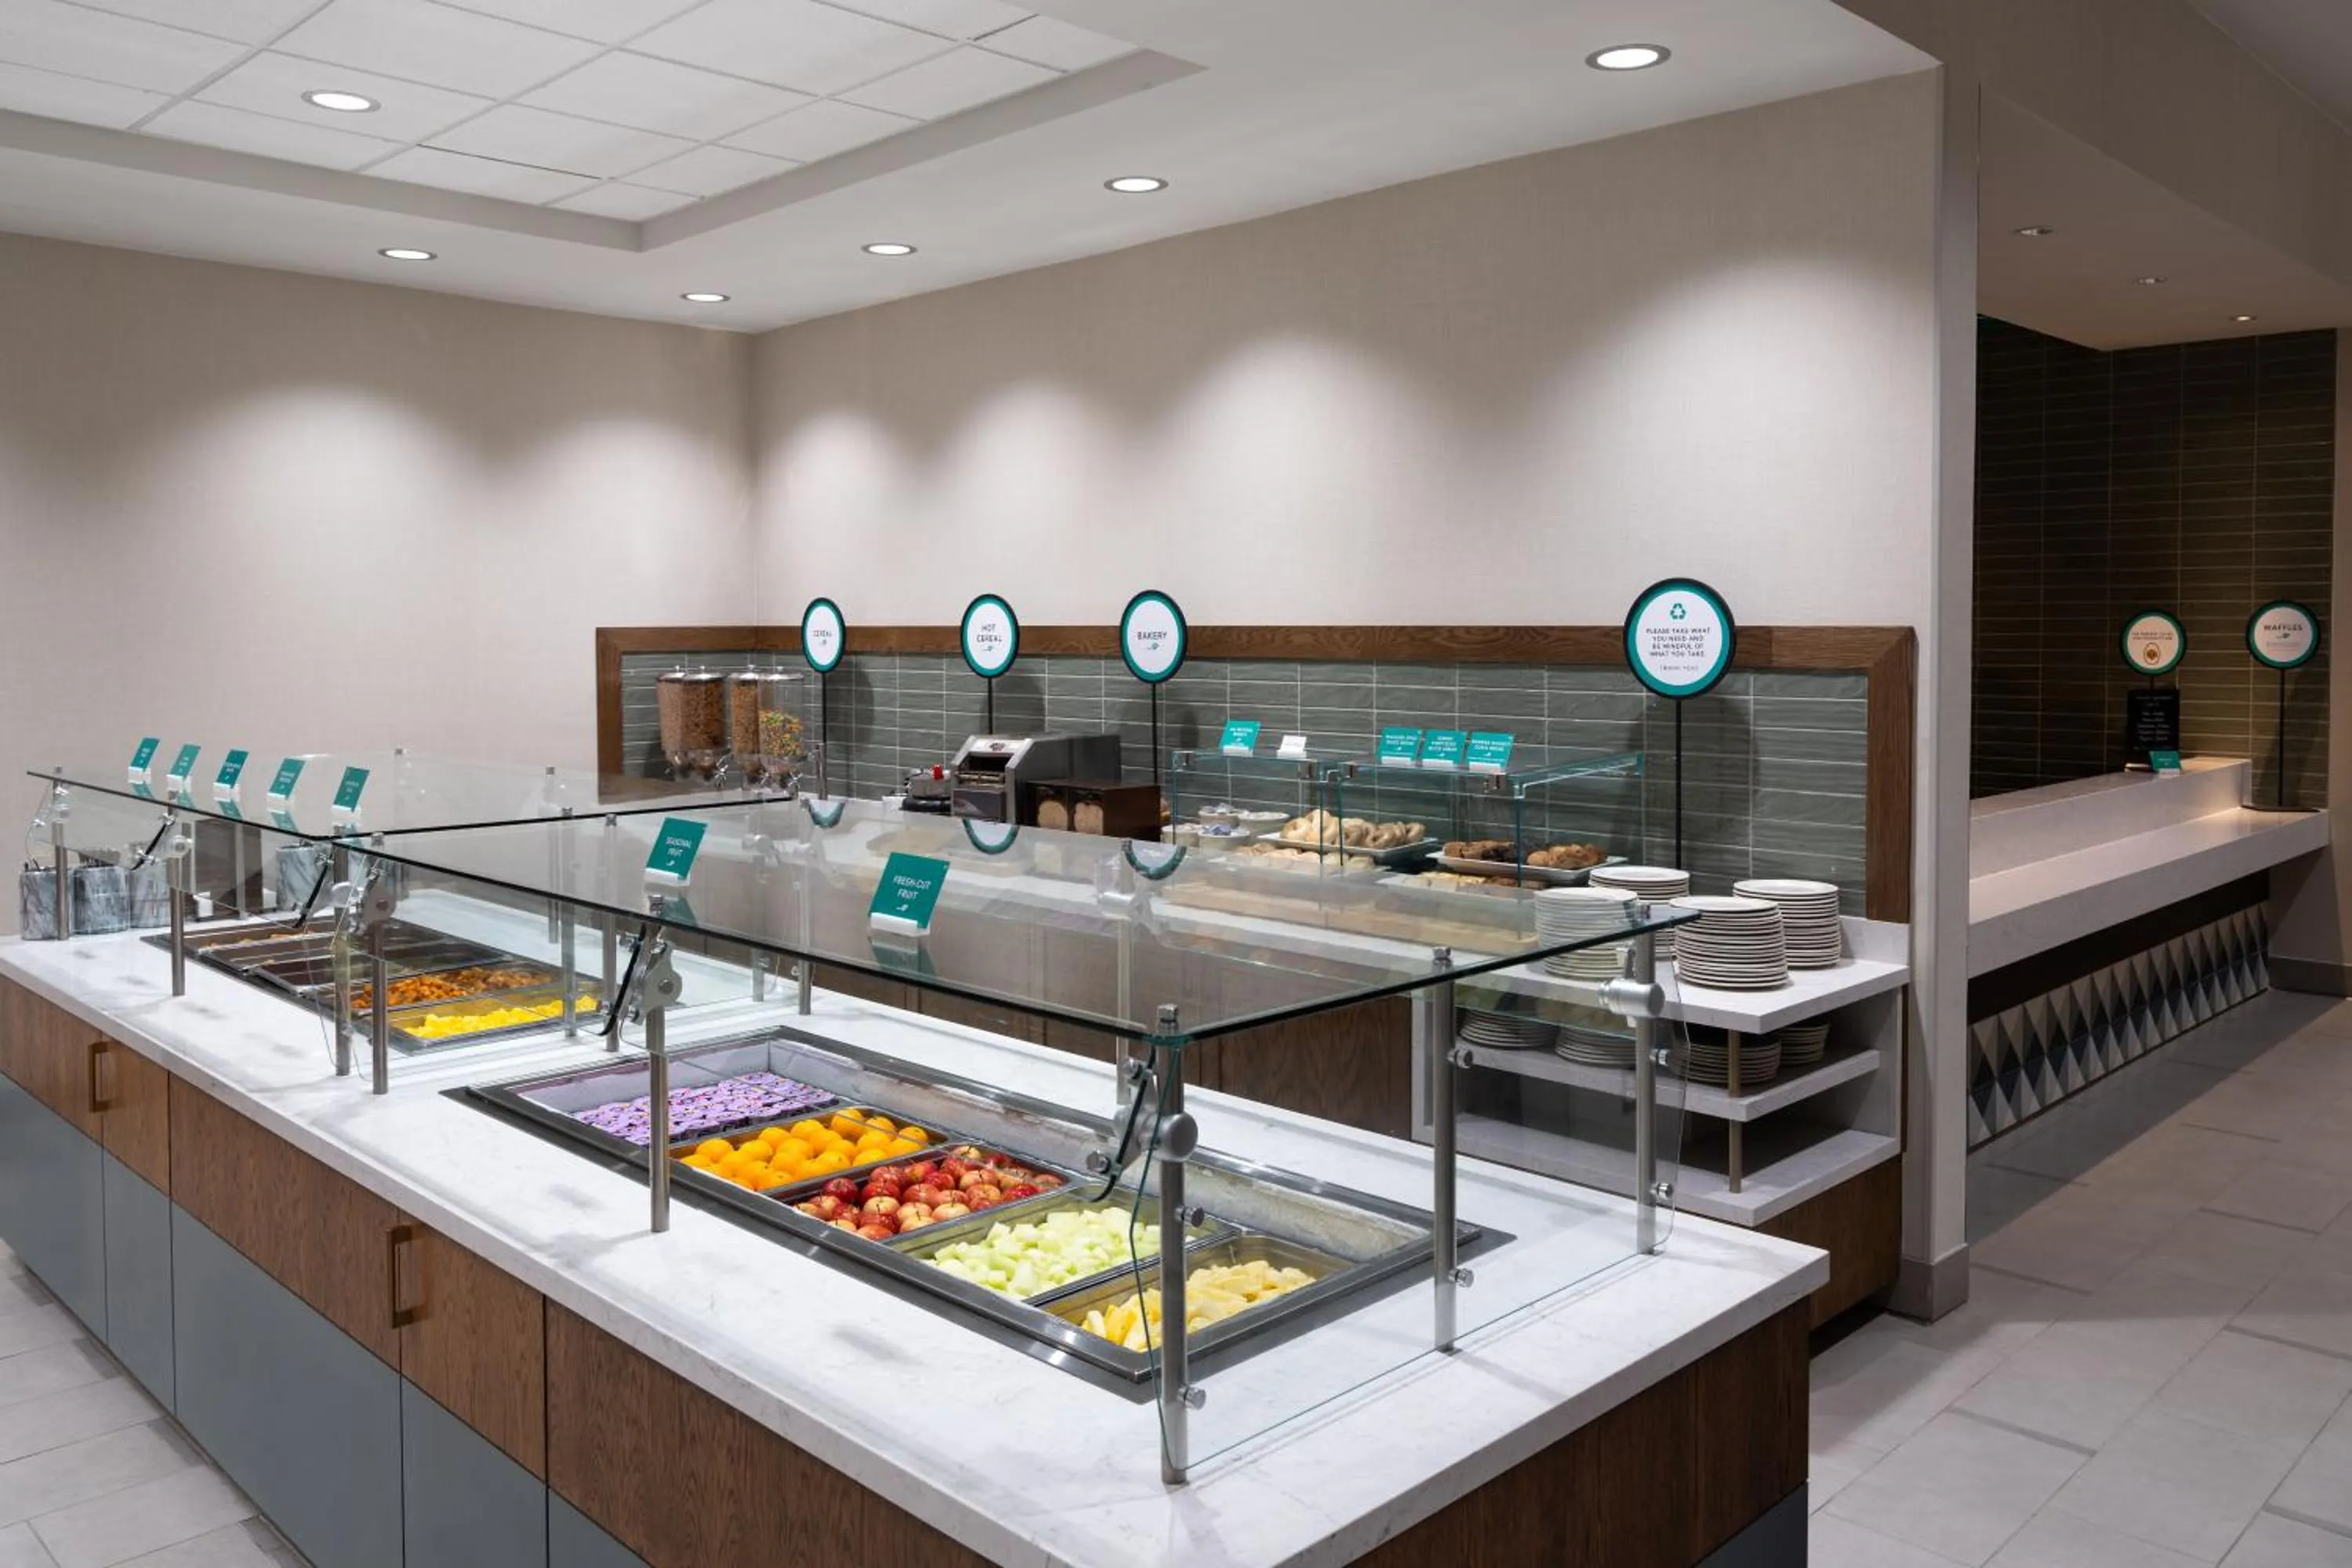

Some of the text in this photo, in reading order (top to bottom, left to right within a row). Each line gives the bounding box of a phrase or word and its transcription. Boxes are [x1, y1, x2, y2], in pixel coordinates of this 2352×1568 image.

[981, 623, 996, 632] HOT
[976, 633, 1003, 643] CEREAL
[1137, 631, 1167, 641] BAKERY
[894, 874, 931, 890] FRESH-CUT
[898, 888, 919, 899] FRUIT
